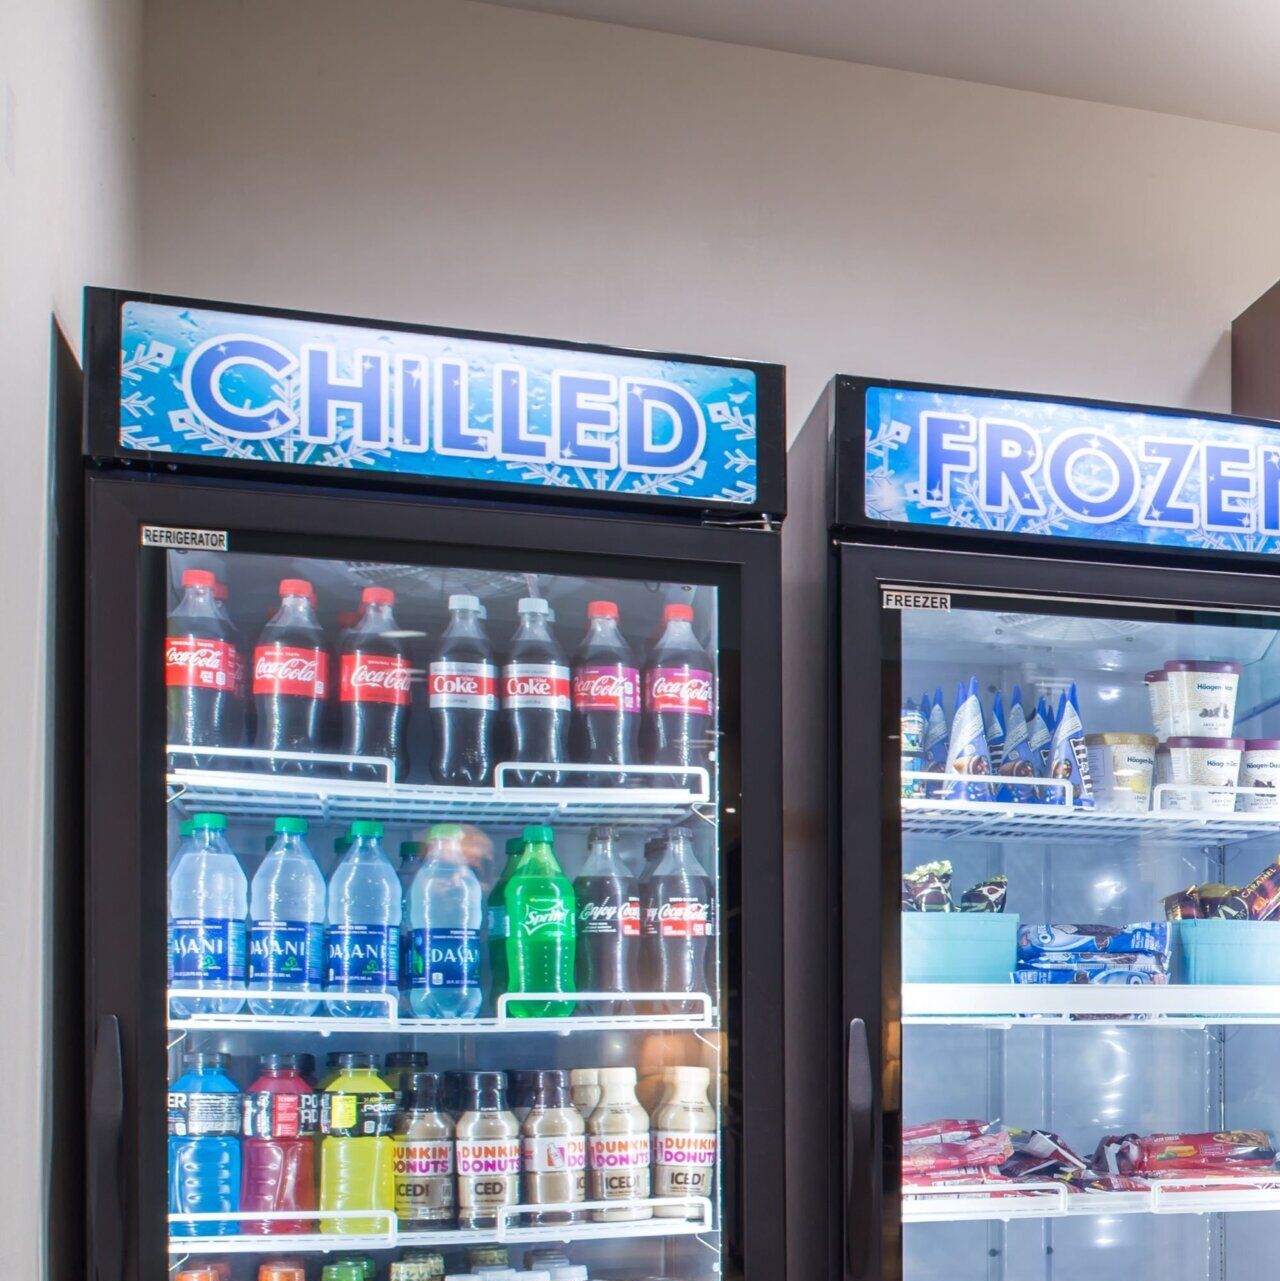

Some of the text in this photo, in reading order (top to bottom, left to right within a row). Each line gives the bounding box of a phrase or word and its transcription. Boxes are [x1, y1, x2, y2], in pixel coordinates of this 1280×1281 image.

[182, 332, 707, 476] CHILLED
[144, 527, 227, 549] REFRIGERATOR
[885, 593, 950, 609] FREEZER
[256, 657, 318, 681] Coca-Cola
[434, 675, 478, 693] Coke
[507, 677, 551, 695] Coke
[1241, 867, 1277, 899] CARAMEL
[579, 896, 618, 920] Enjoy
